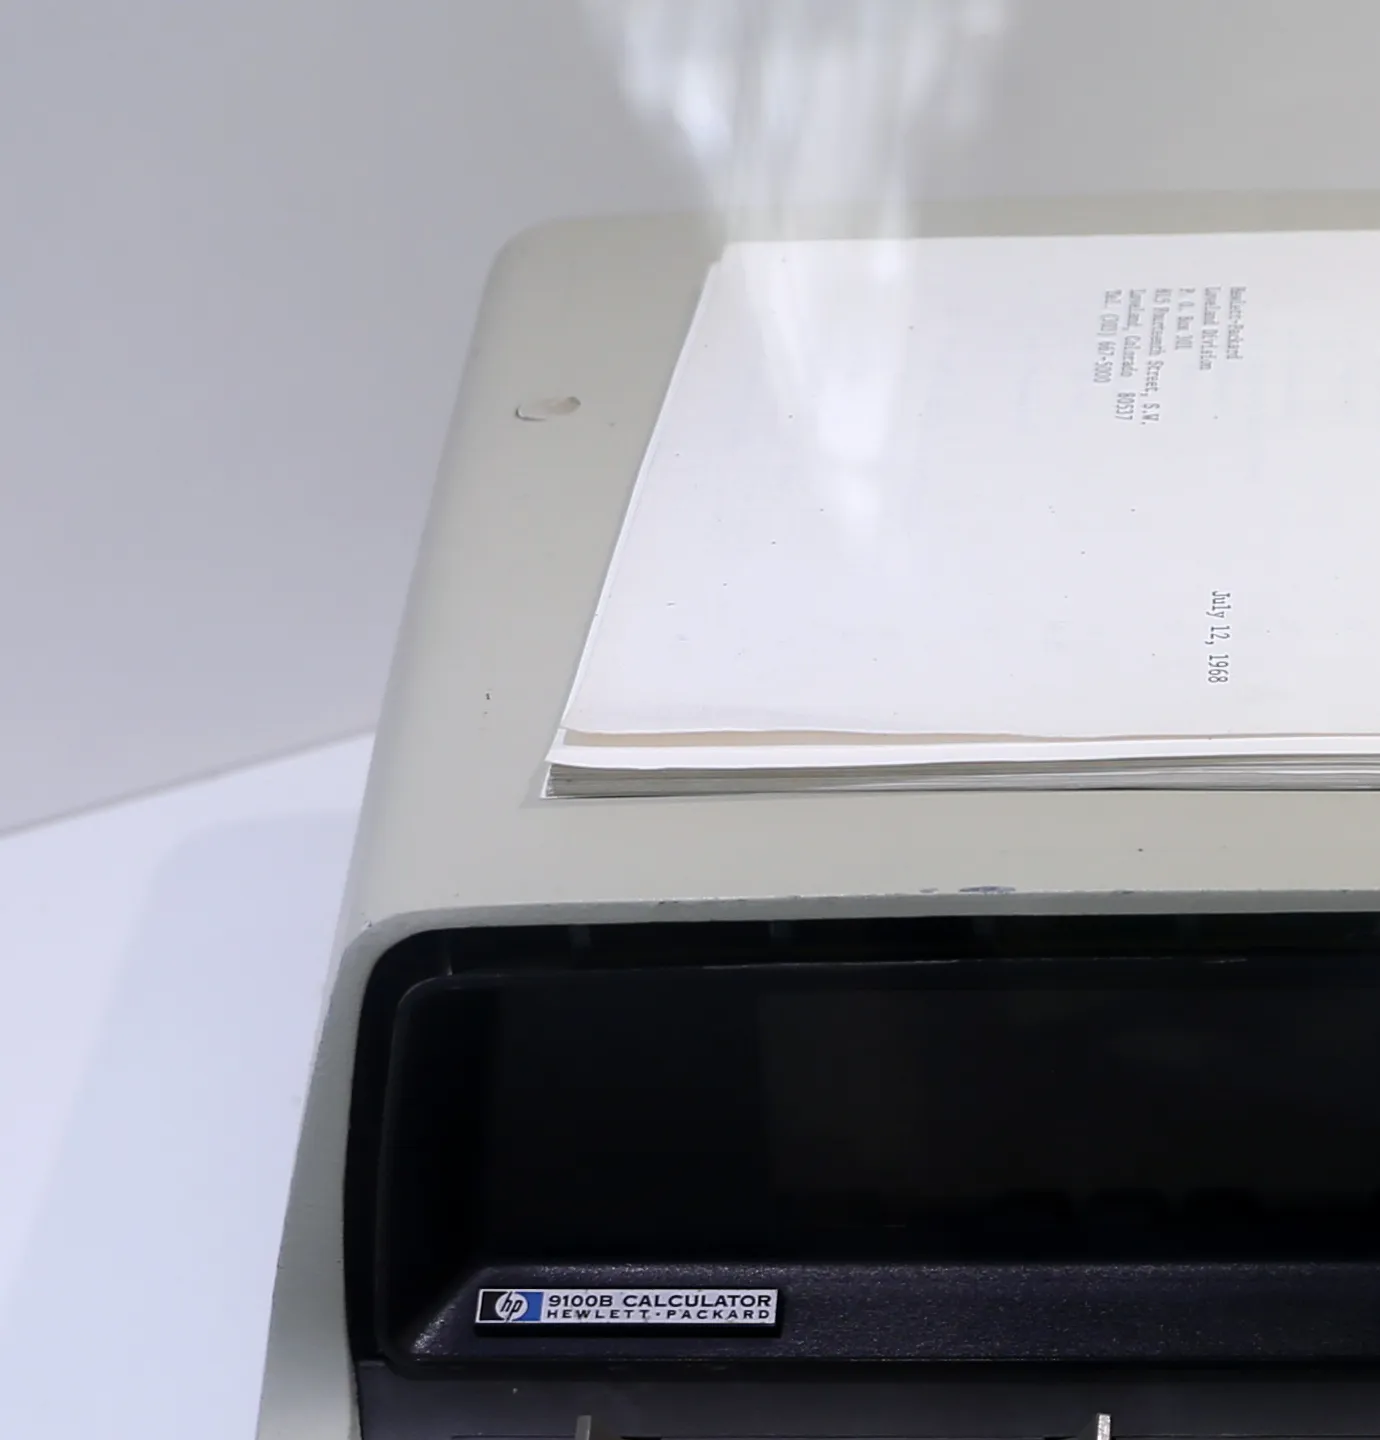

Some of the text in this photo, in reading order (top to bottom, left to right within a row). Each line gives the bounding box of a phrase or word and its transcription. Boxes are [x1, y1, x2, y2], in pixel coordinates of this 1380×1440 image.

[1200, 329, 1218, 370] Division
[1140, 361, 1164, 396] Street,
[1115, 393, 1135, 420] 80537
[1141, 403, 1160, 424] S.W.
[1205, 591, 1231, 683] July 12, 1968
[499, 1291, 524, 1322] hp
[548, 1295, 772, 1308] 9100B CALCULATOR
